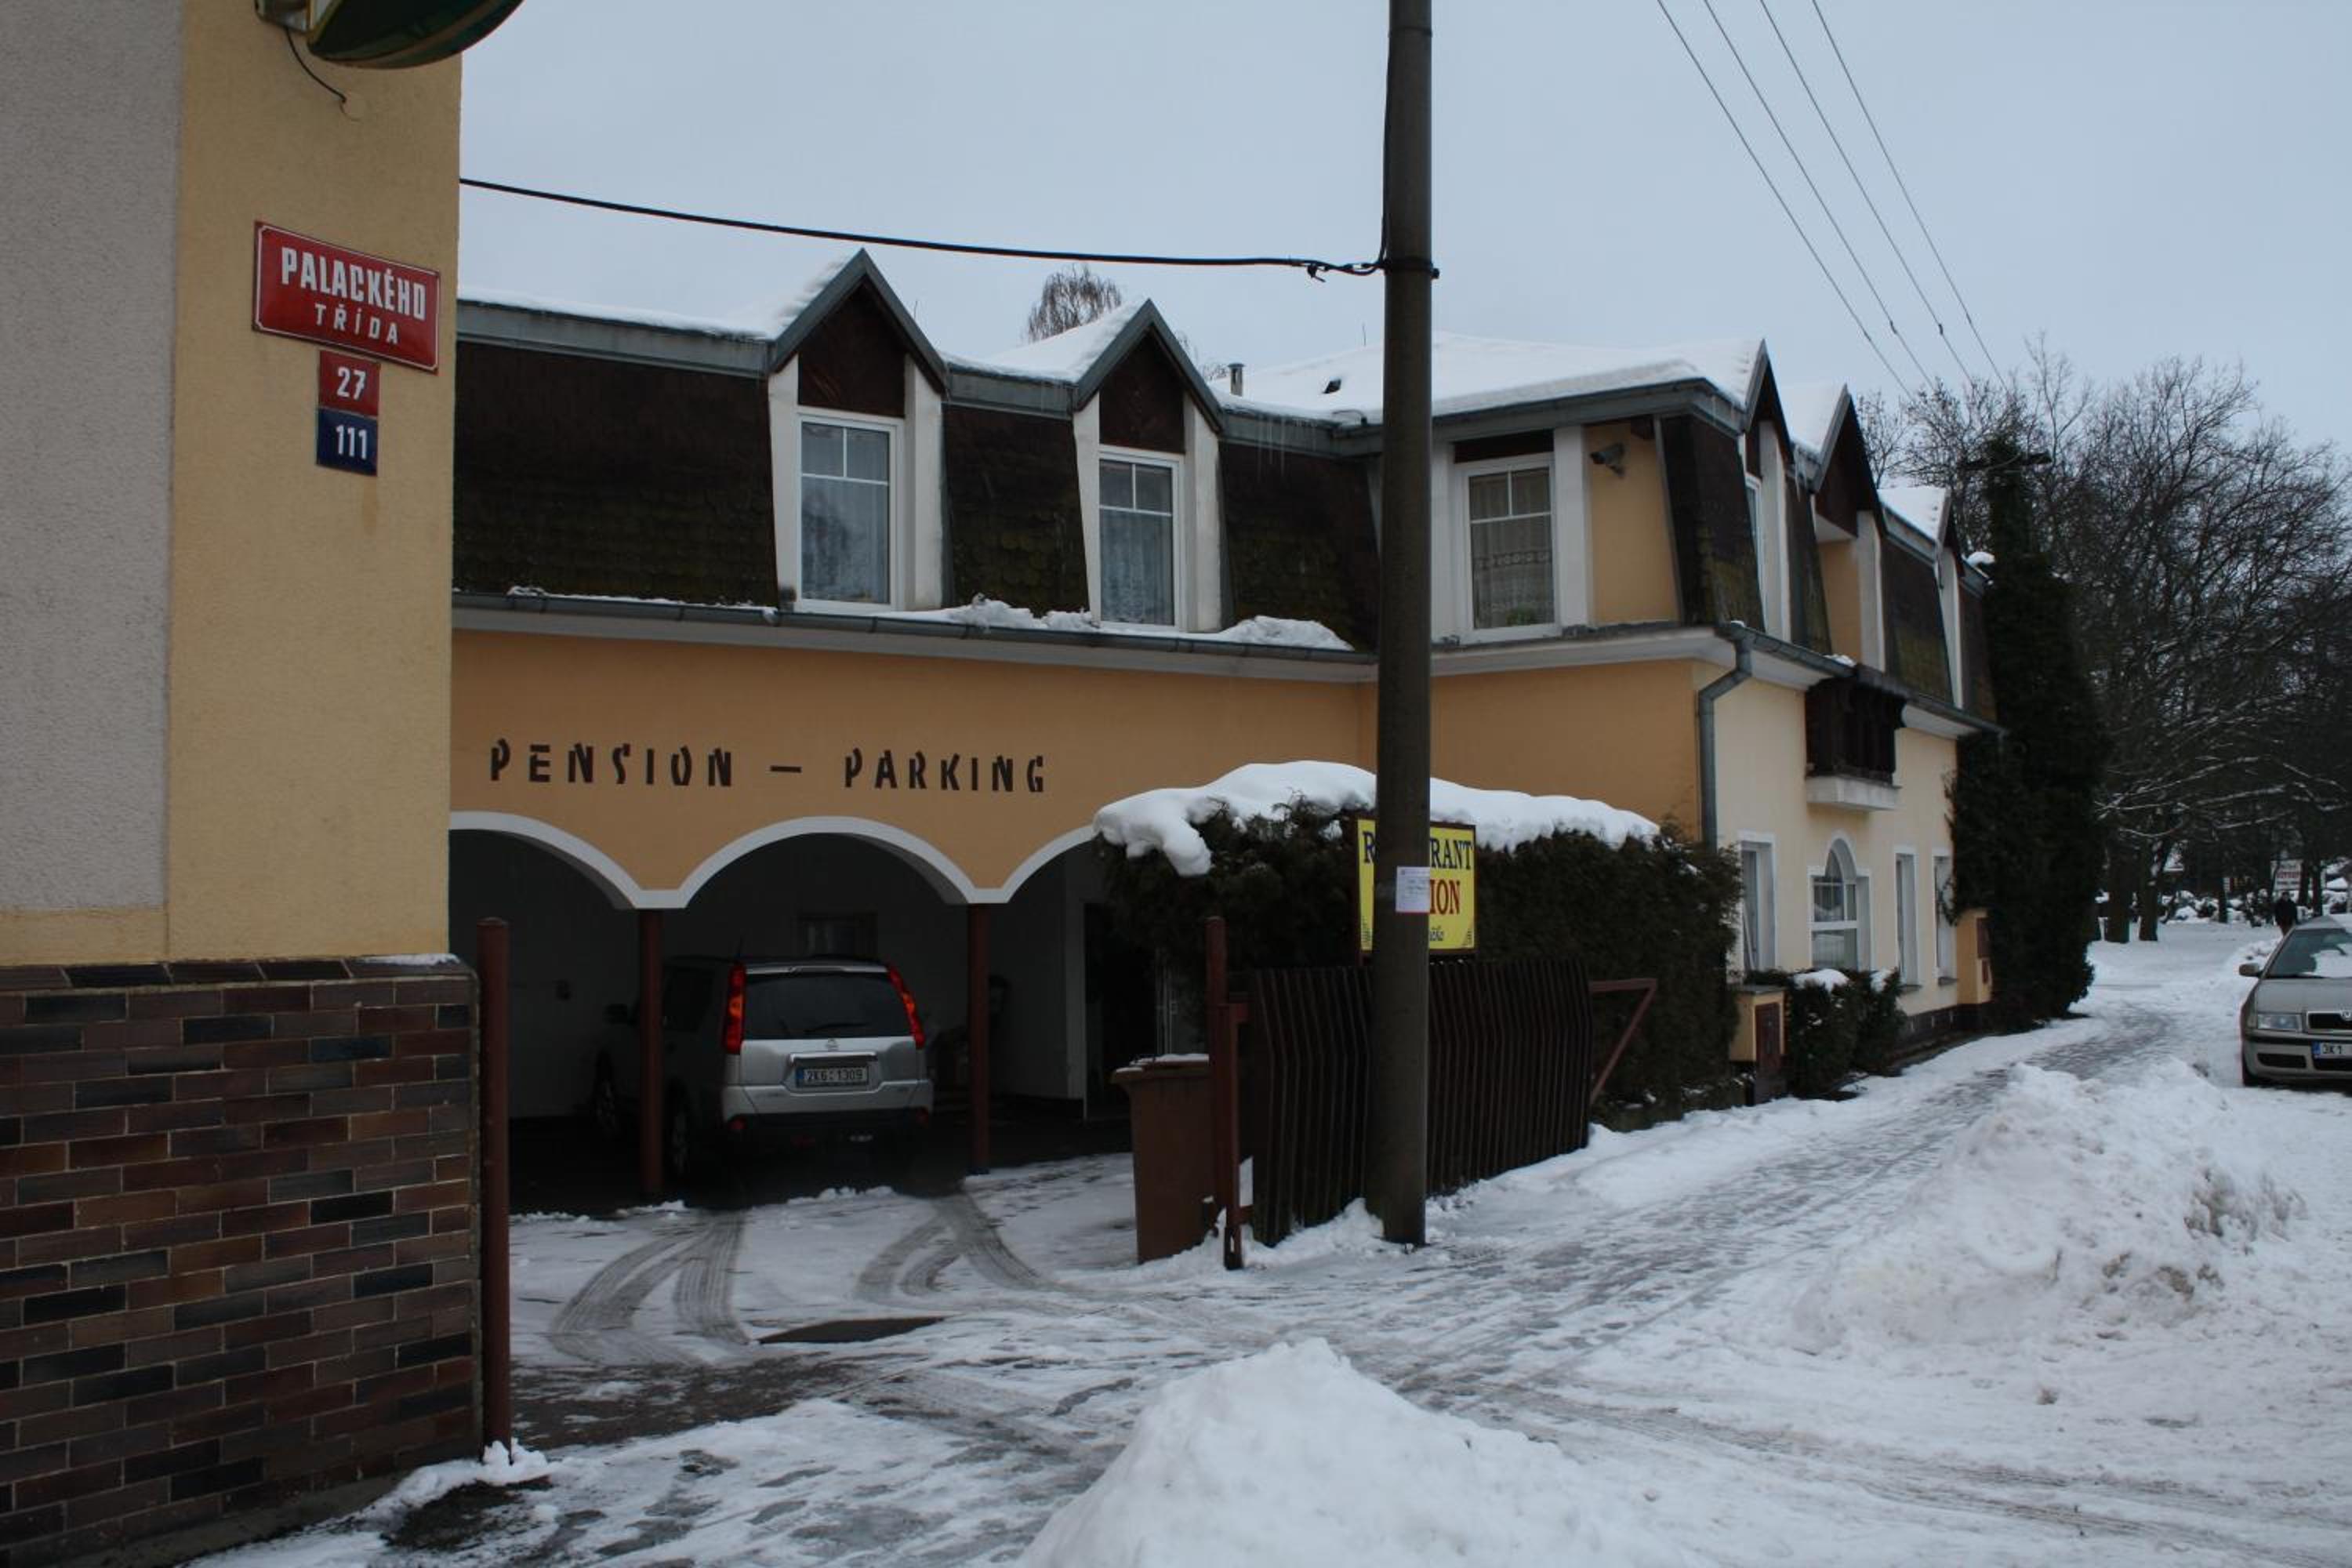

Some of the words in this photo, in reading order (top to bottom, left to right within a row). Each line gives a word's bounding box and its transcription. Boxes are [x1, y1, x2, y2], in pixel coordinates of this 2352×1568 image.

[281, 246, 427, 321] PALACKÉHO
[314, 303, 398, 345] TŘÍDA
[336, 367, 367, 400] 27
[336, 424, 368, 460] 111
[490, 737, 731, 787] PENSION
[844, 747, 1044, 793] PARKING
